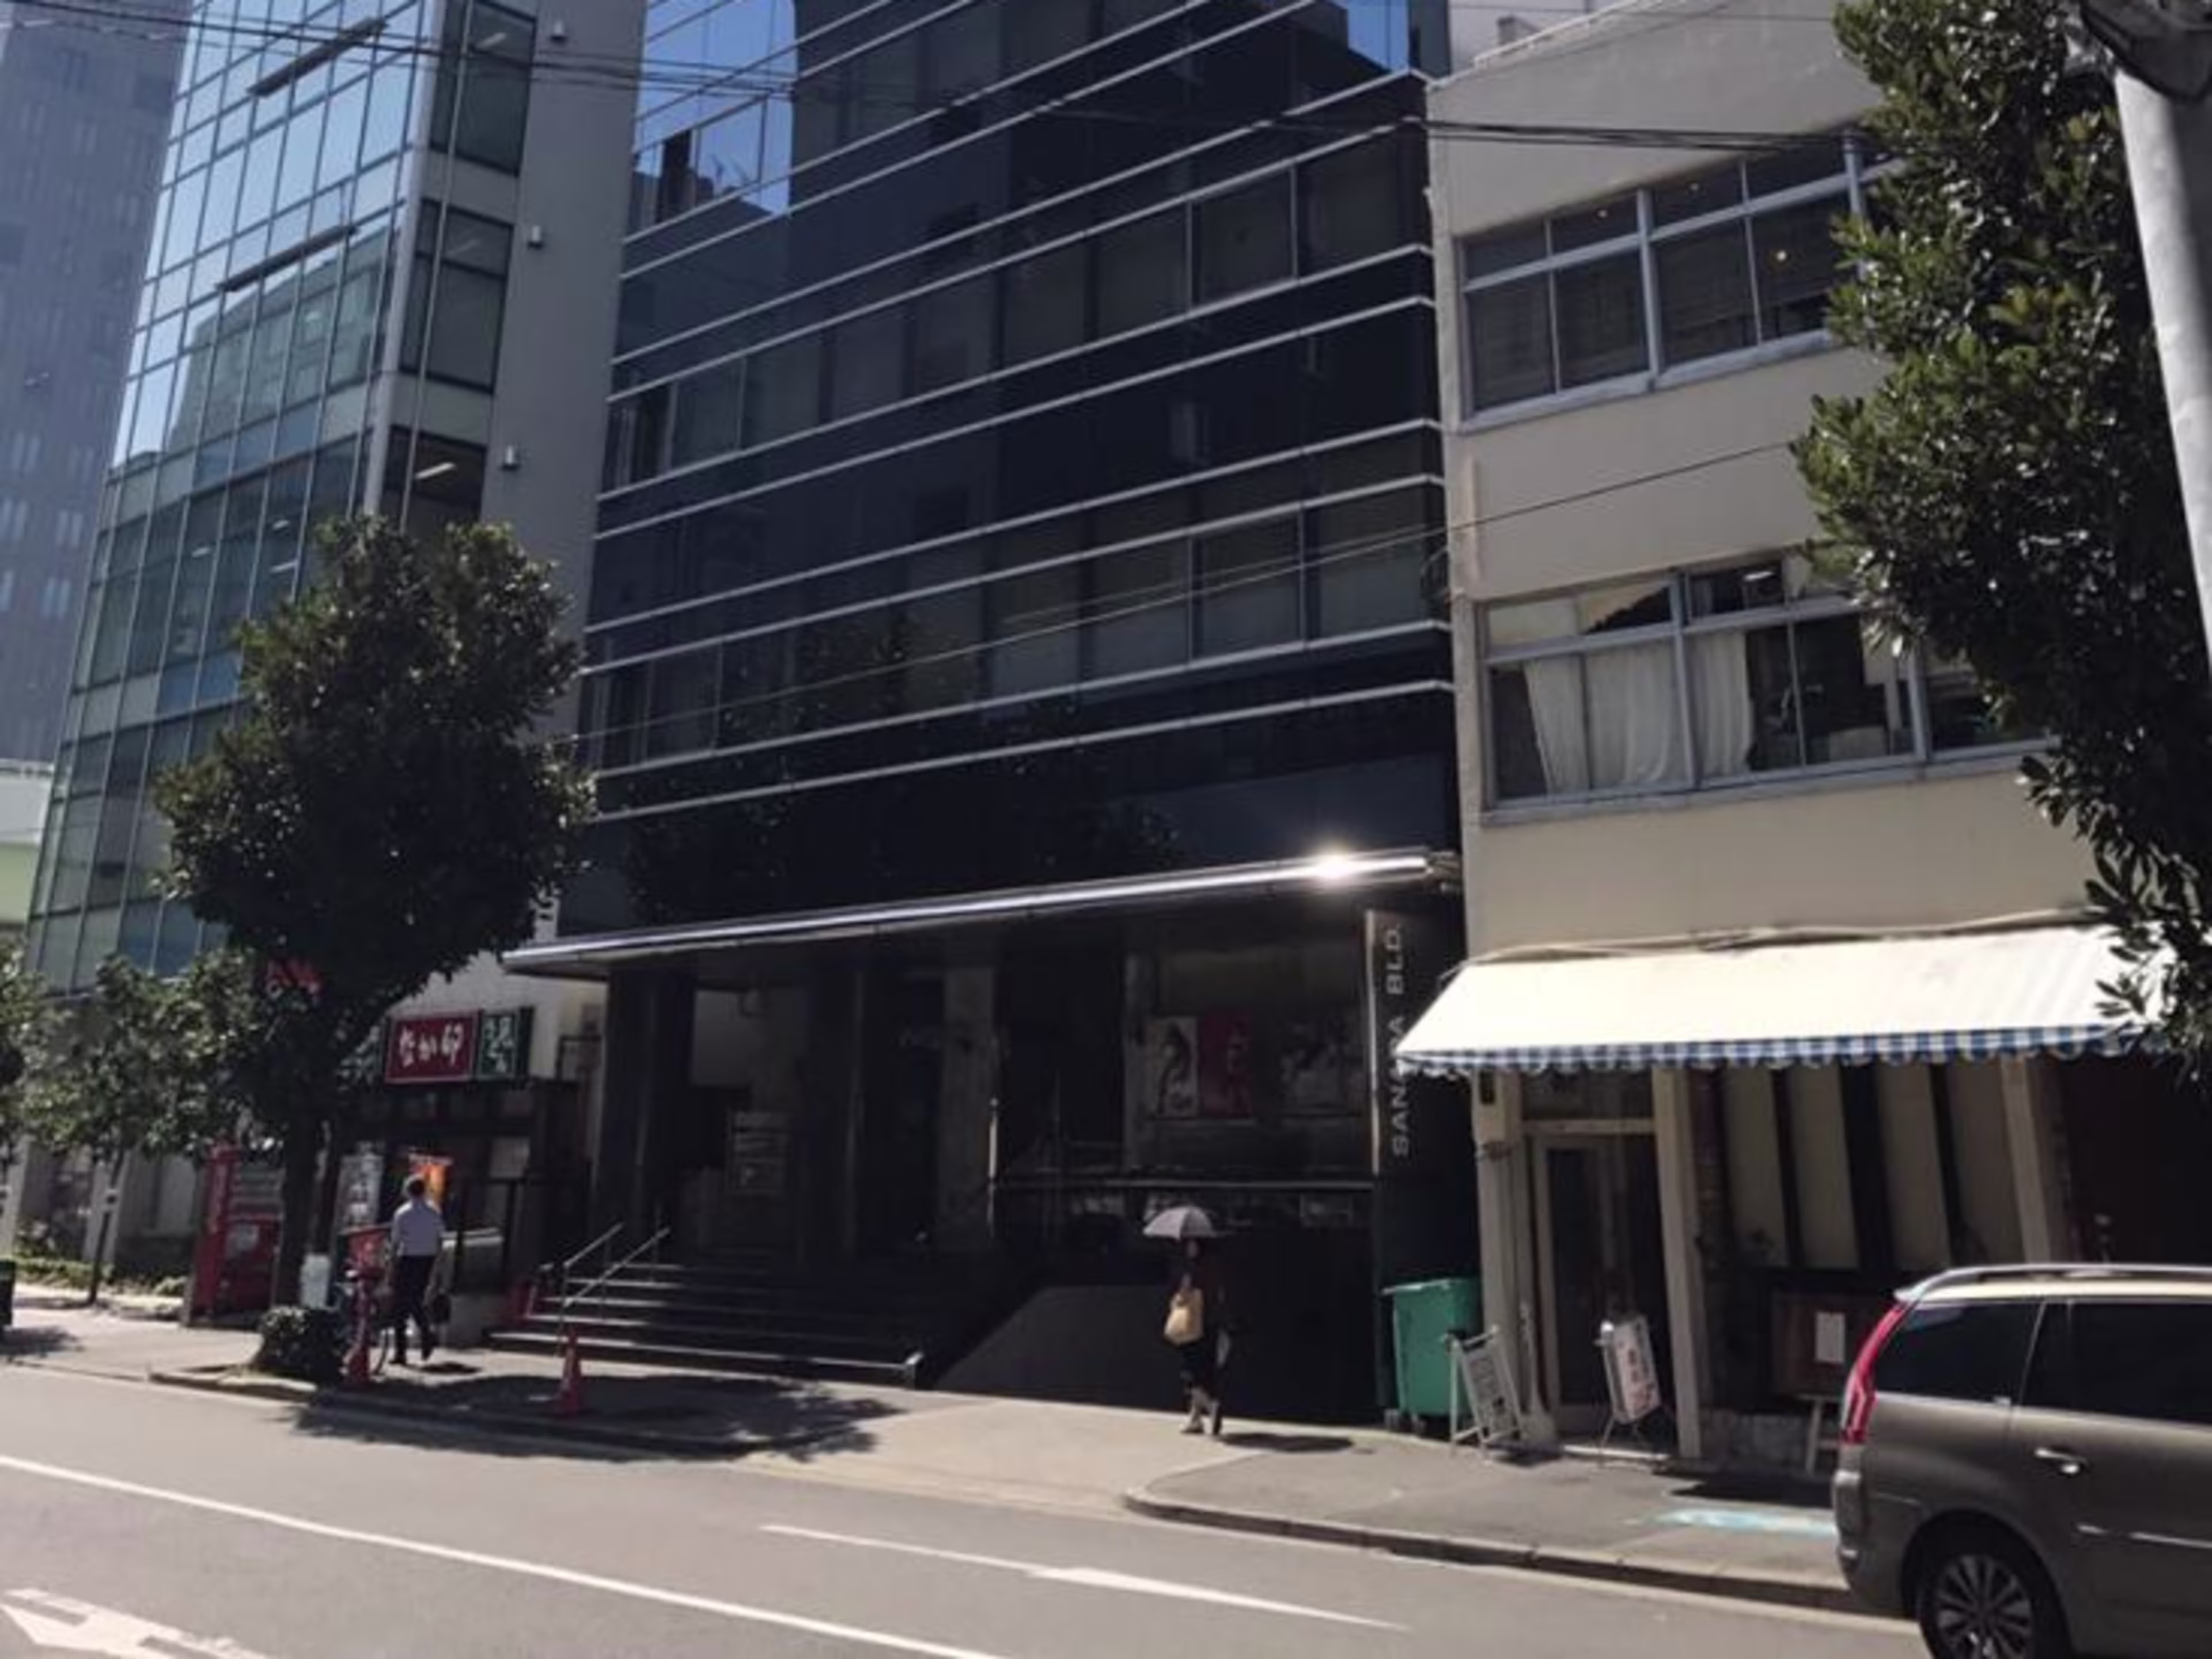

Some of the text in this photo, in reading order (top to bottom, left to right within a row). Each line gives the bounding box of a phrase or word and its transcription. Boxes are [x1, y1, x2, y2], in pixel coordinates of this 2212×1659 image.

[399, 1024, 464, 1069] なか卯
[1387, 1016, 1410, 1157] SANA
